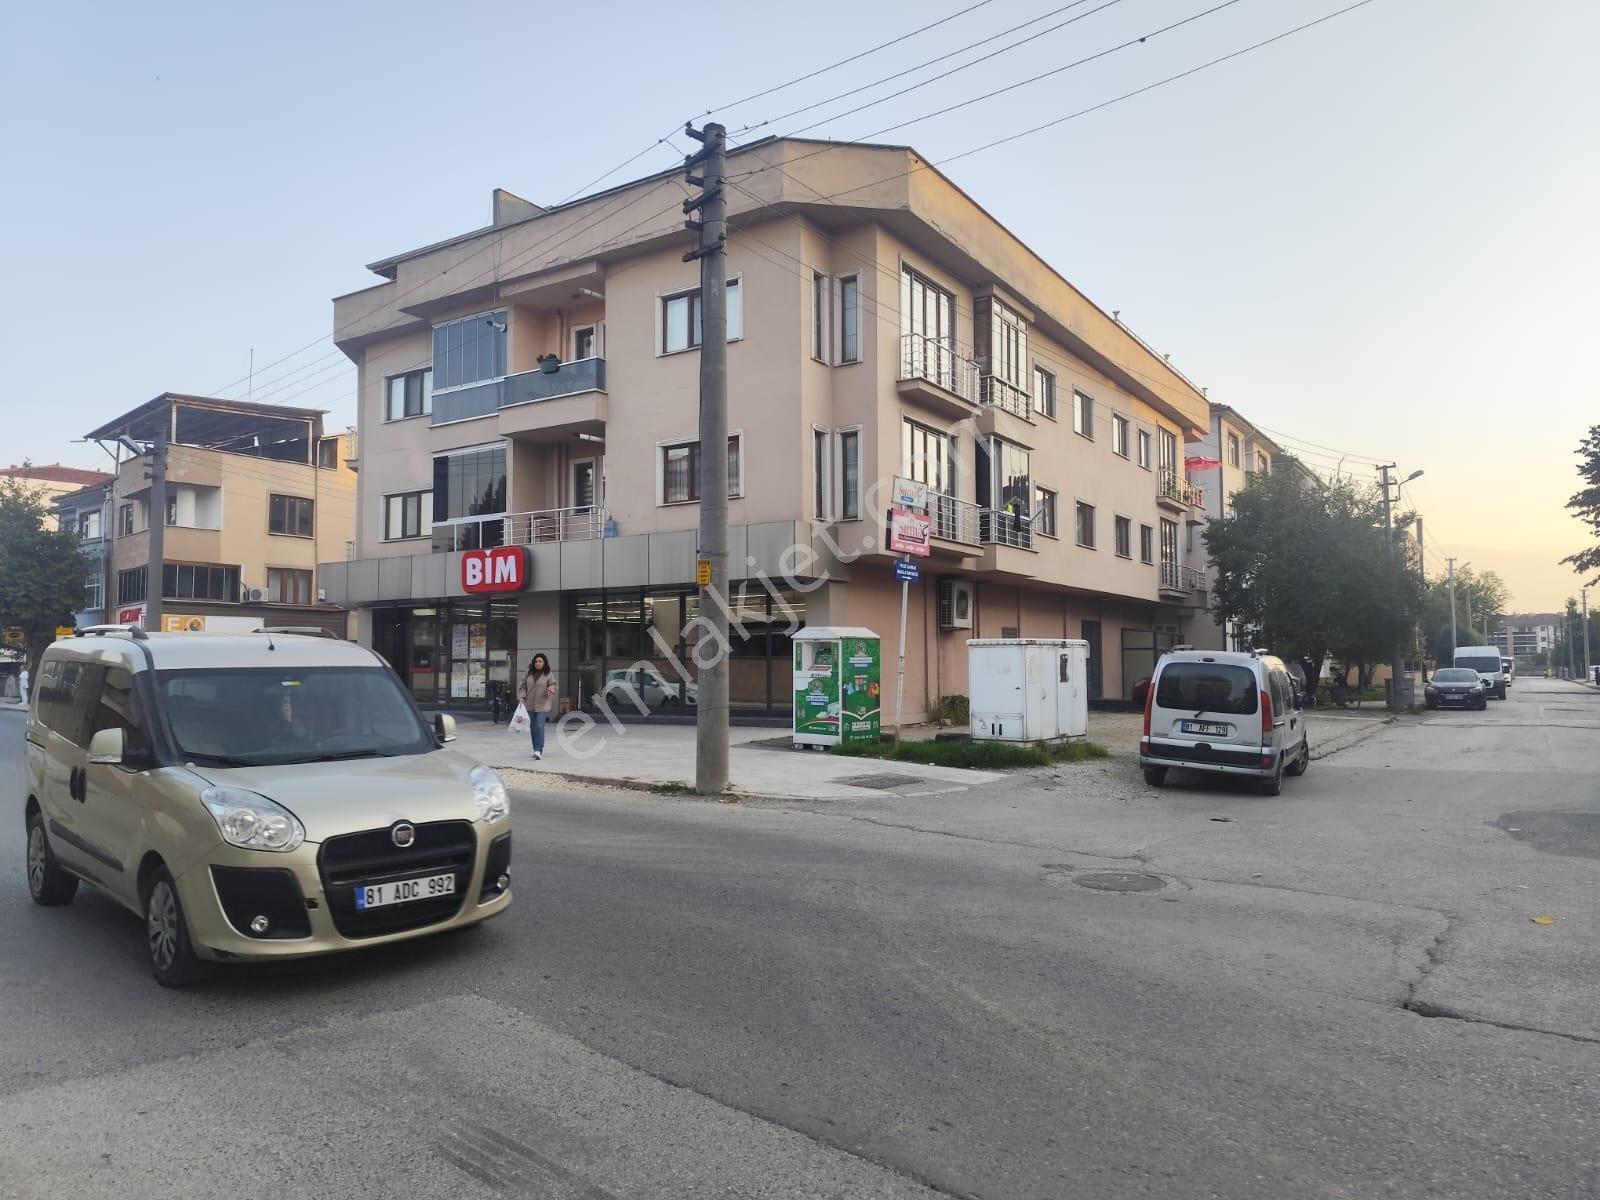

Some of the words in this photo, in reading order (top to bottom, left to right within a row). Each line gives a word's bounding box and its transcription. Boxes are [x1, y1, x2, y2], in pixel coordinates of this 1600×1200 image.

[466, 549, 516, 586] BİM
[366, 887, 383, 905] 81
[394, 881, 420, 902] ADC
[428, 876, 454, 895] 992
